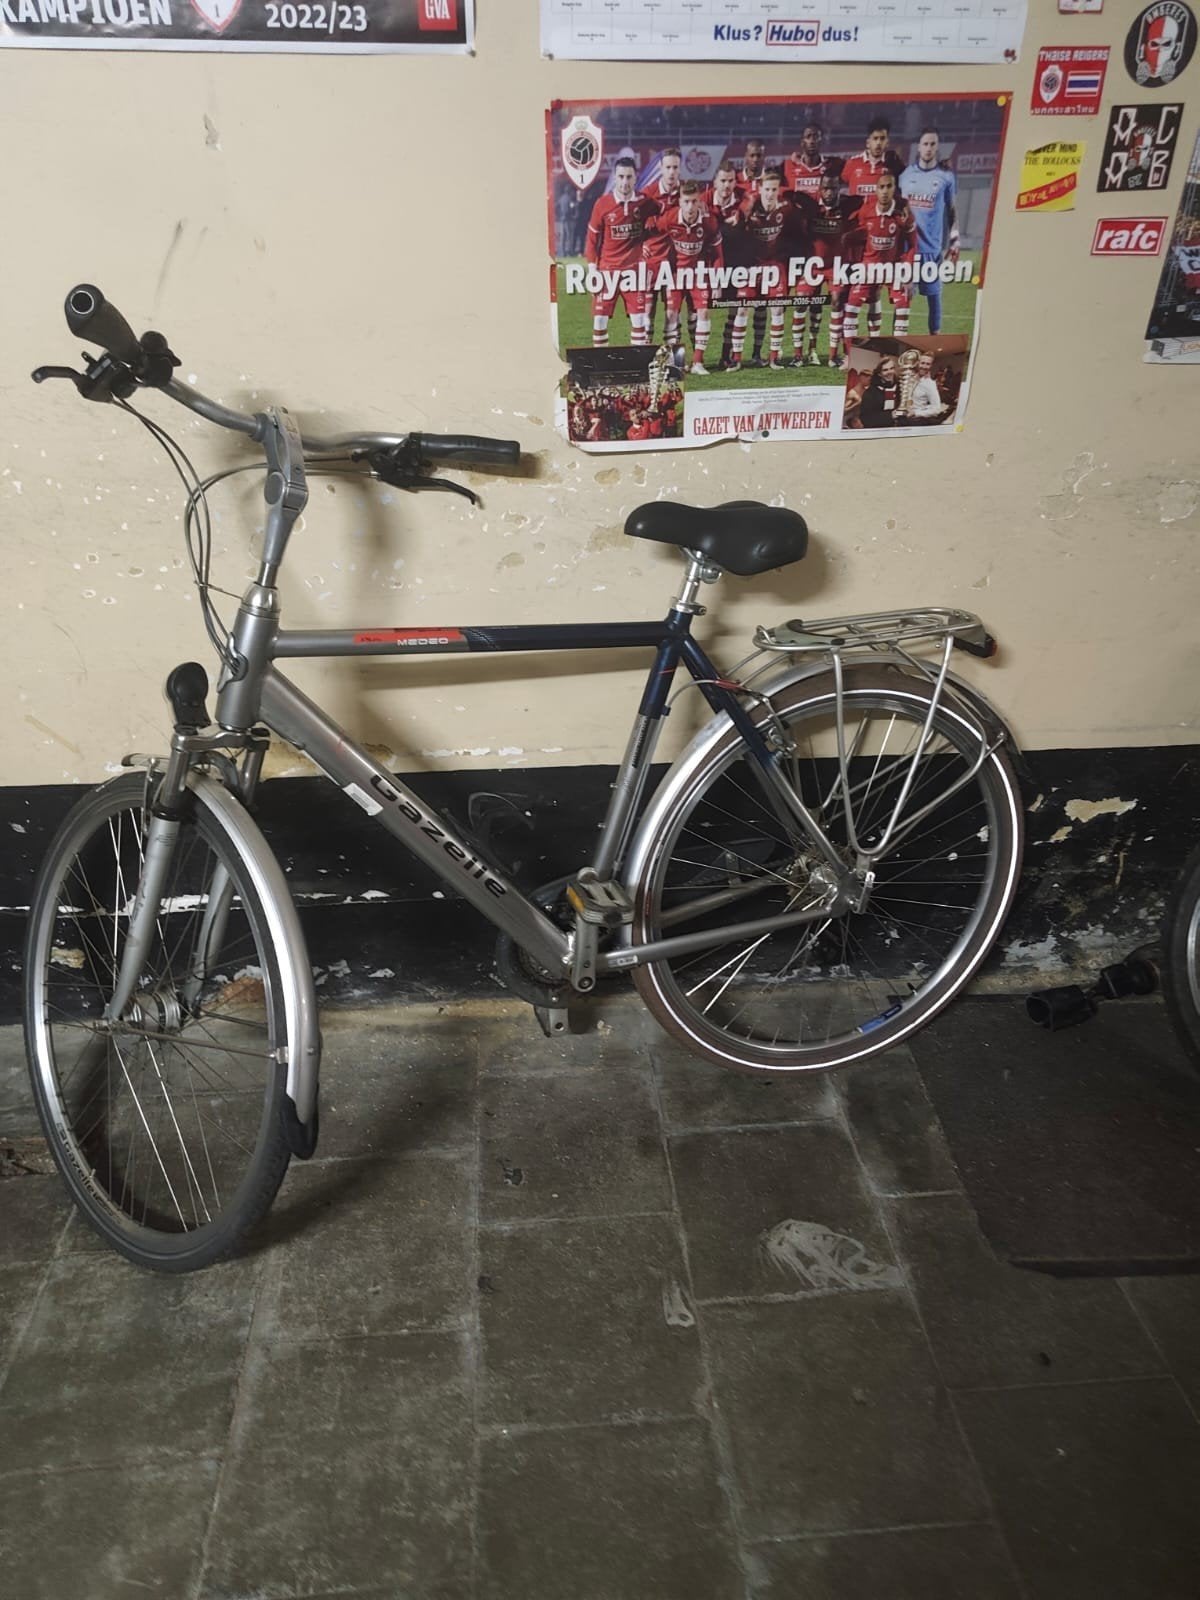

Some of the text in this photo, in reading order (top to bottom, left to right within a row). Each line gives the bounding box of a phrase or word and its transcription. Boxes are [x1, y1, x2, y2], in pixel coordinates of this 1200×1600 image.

[264, 1, 368, 34] 2022/23
[424, 0, 451, 20] GVA
[713, 24, 859, 41] Klus? Hubo dus!
[1098, 223, 1159, 249] rafc
[566, 254, 974, 300] Royal Antwerp FC kampioen
[743, 299, 766, 308] League
[793, 297, 827, 305] 2016-2017
[693, 411, 832, 435] GAZET VAN ANTWERPEN
[370, 774, 506, 898] Gazelle
